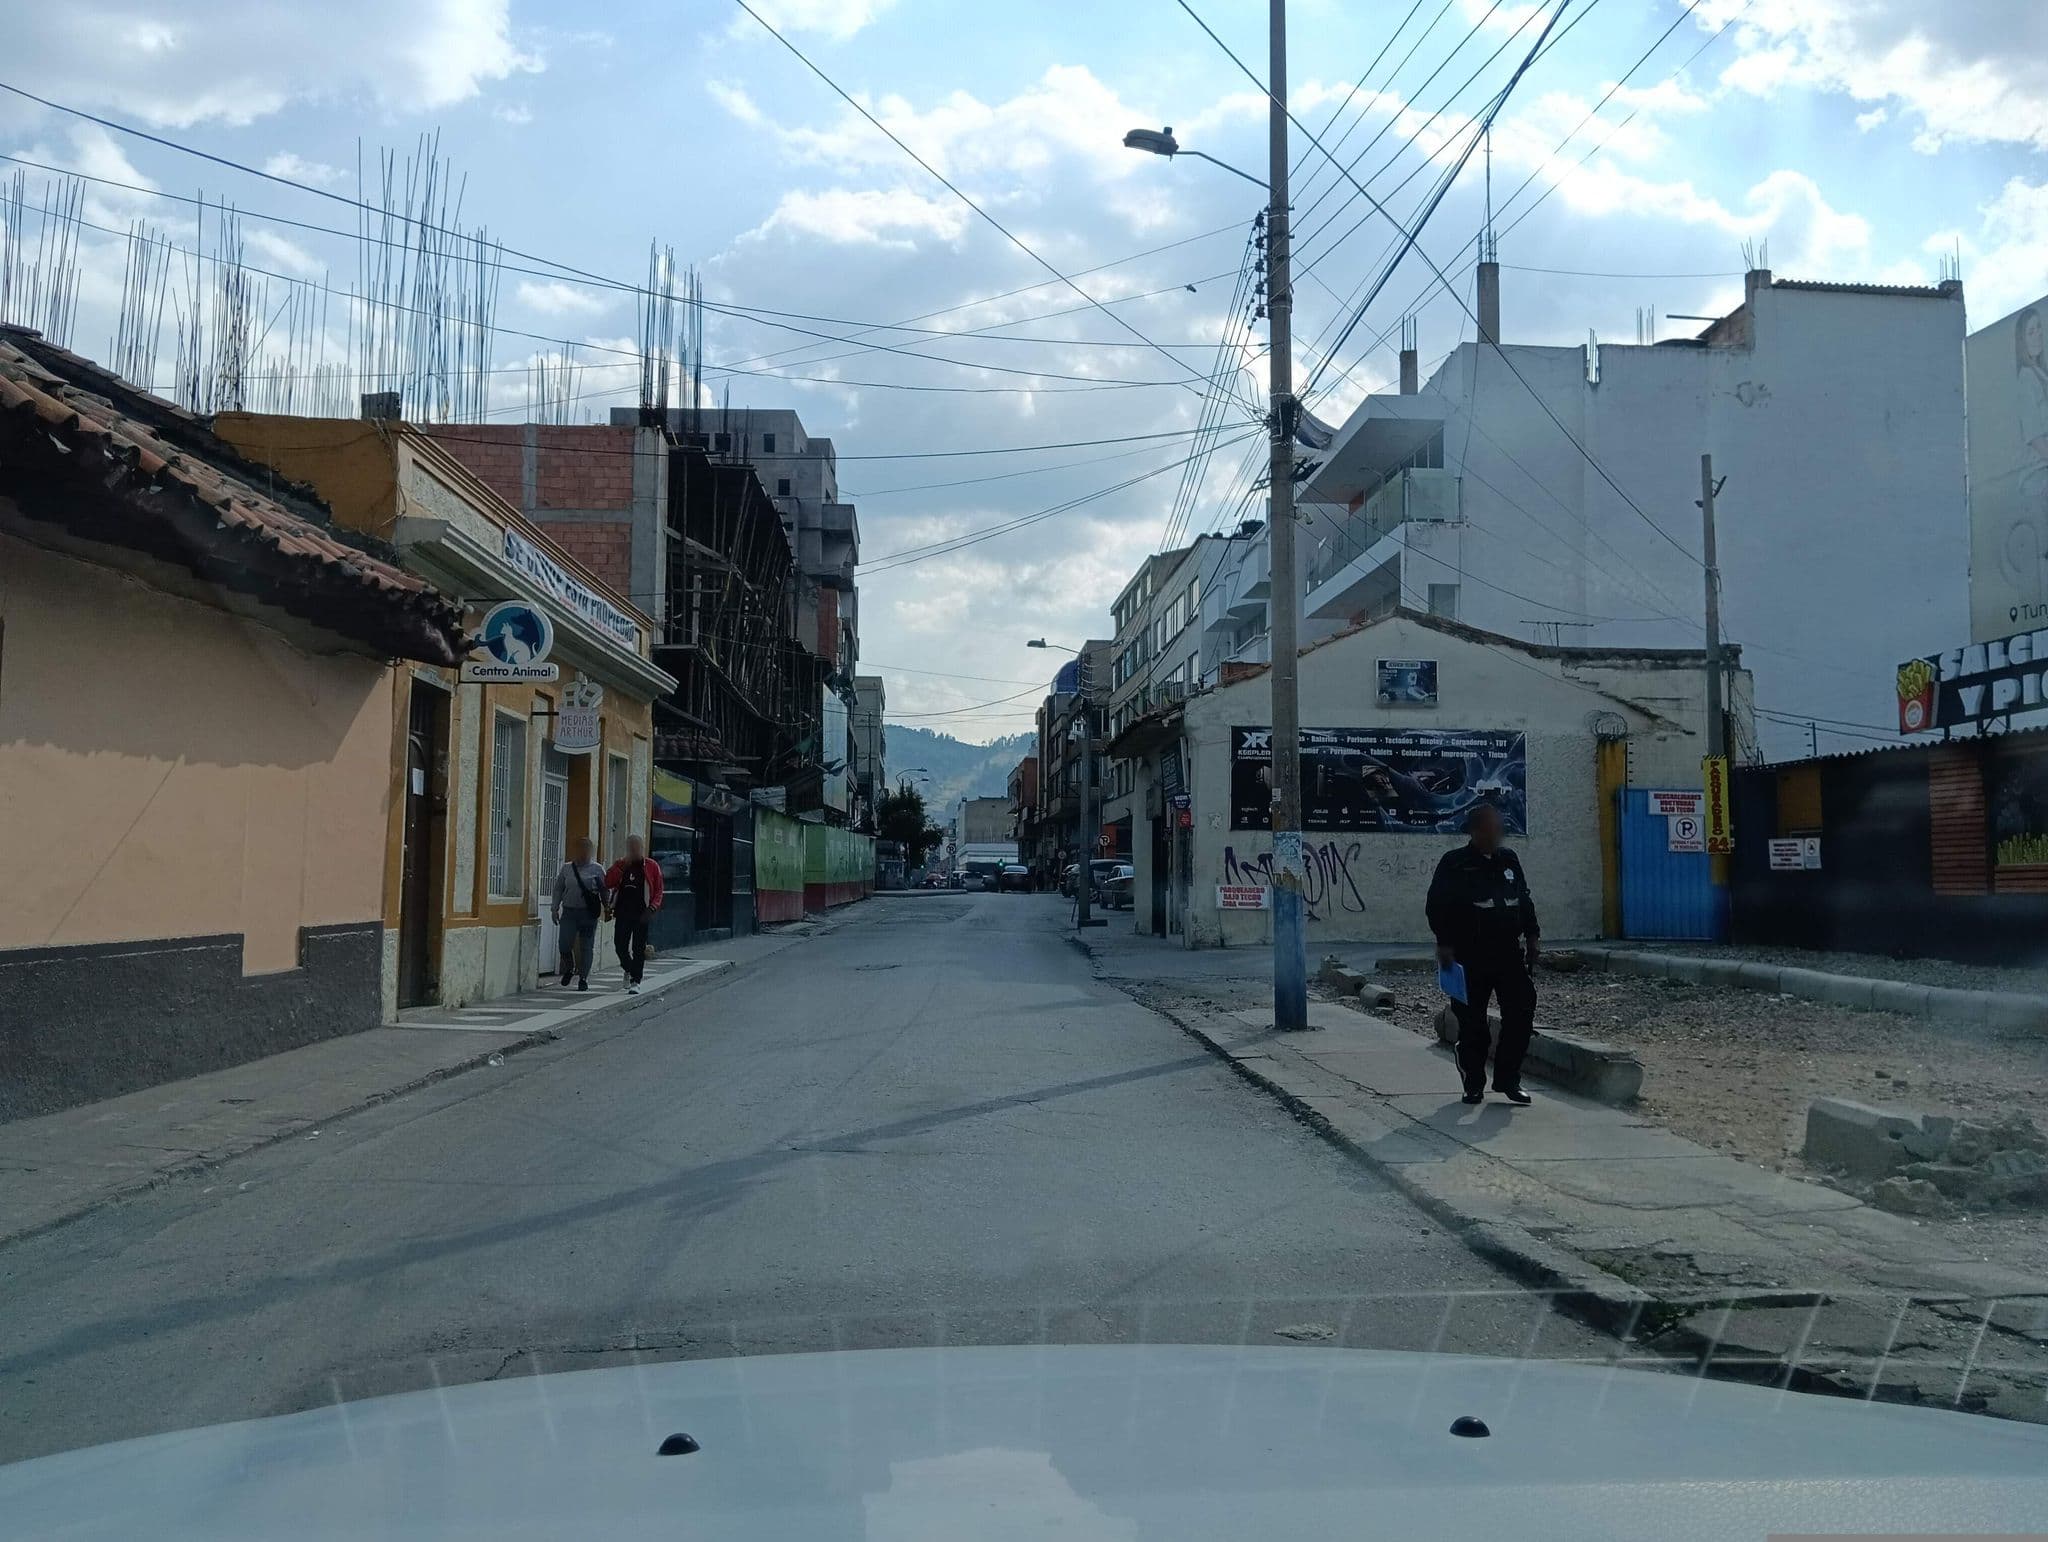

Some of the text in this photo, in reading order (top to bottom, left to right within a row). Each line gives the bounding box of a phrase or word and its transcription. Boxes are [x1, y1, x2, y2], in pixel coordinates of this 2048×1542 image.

[2021, 604, 2048, 620] Tun
[472, 666, 551, 678] Centro Animal
[1958, 669, 2048, 717] Y PI
[561, 715, 593, 725] MEDIAS
[560, 727, 593, 737] ARTHUR
[1401, 749, 1431, 757] Celulares
[1441, 750, 1477, 758] Impresoras
